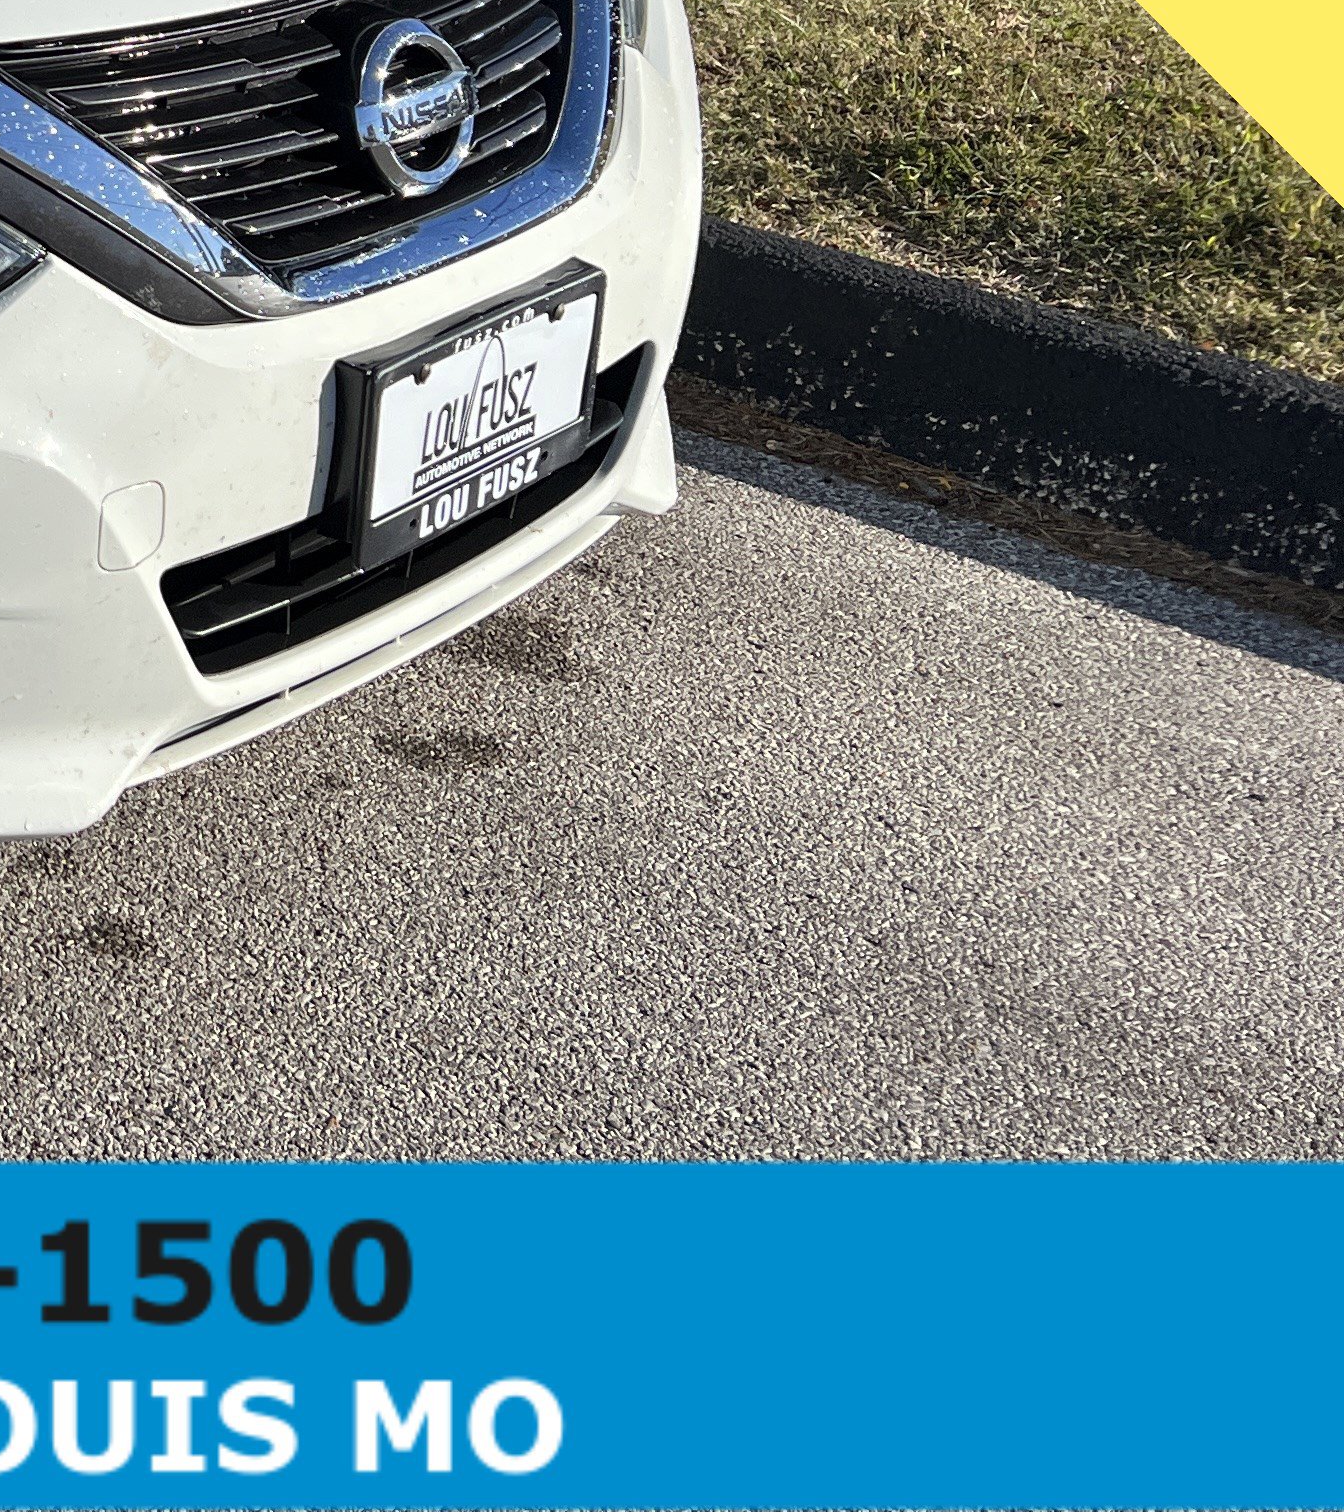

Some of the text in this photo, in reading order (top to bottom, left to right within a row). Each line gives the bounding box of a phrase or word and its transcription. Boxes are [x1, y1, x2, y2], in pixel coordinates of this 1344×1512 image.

[381, 75, 475, 135] NISSAN
[454, 307, 535, 354] fusz.com
[421, 361, 538, 465] LOU FUSZ
[415, 421, 534, 489] AUTOMOTIVE NETWORK
[419, 446, 541, 538] LOU FUSZ
